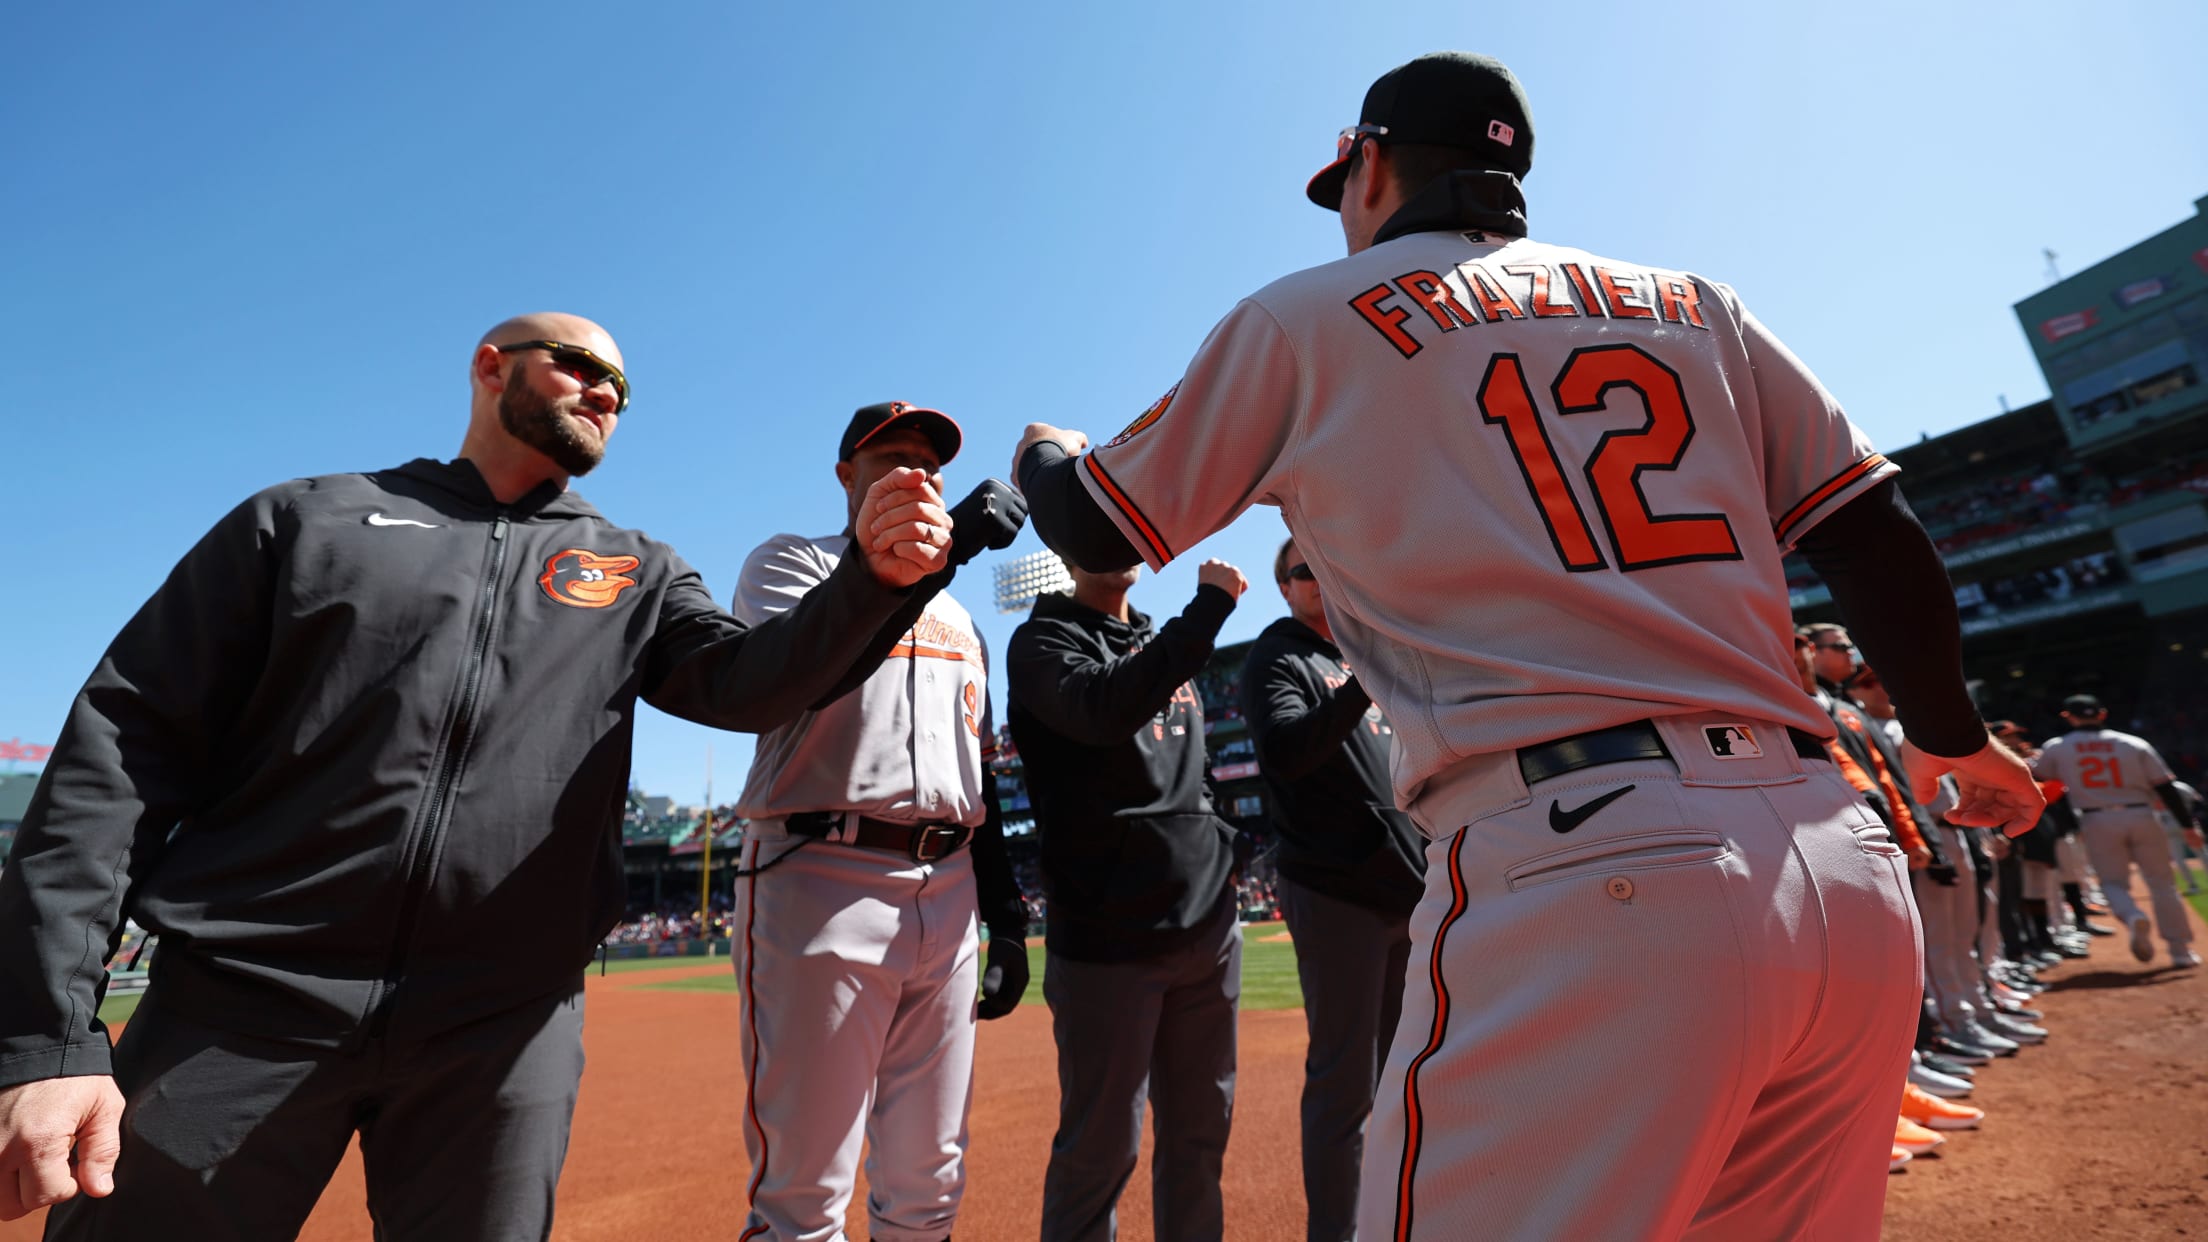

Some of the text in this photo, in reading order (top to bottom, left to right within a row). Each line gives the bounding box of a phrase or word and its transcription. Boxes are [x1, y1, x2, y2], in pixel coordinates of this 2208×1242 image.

[1348, 262, 1709, 360] FRAZIER
[1475, 342, 1744, 573] 12
[2079, 755, 2124, 790] 21
